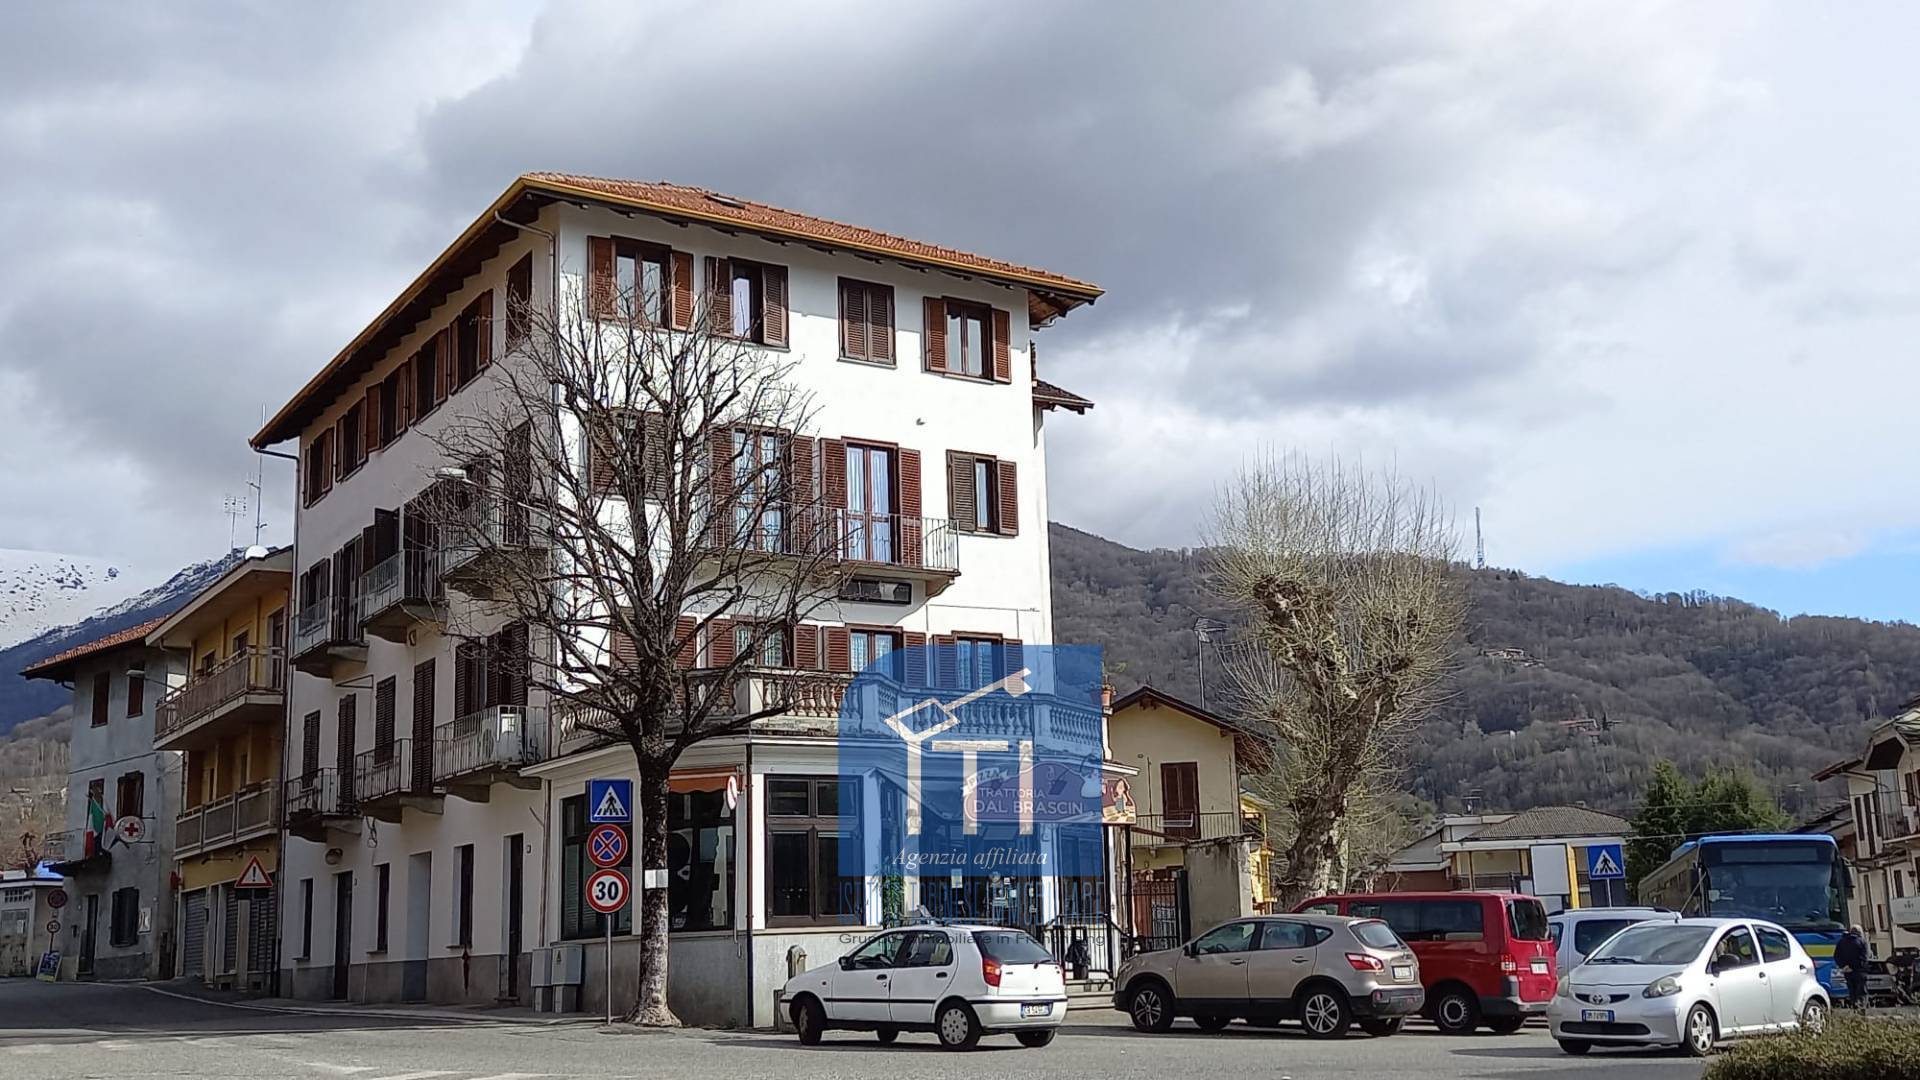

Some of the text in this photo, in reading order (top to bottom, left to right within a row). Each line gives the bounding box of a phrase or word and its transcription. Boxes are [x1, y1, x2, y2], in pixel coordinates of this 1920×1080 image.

[968, 769, 1000, 787] PIZZA
[979, 787, 1046, 799] TRATTORIA
[973, 800, 1084, 814] DAL BRASCIN
[595, 881, 619, 900] 30
